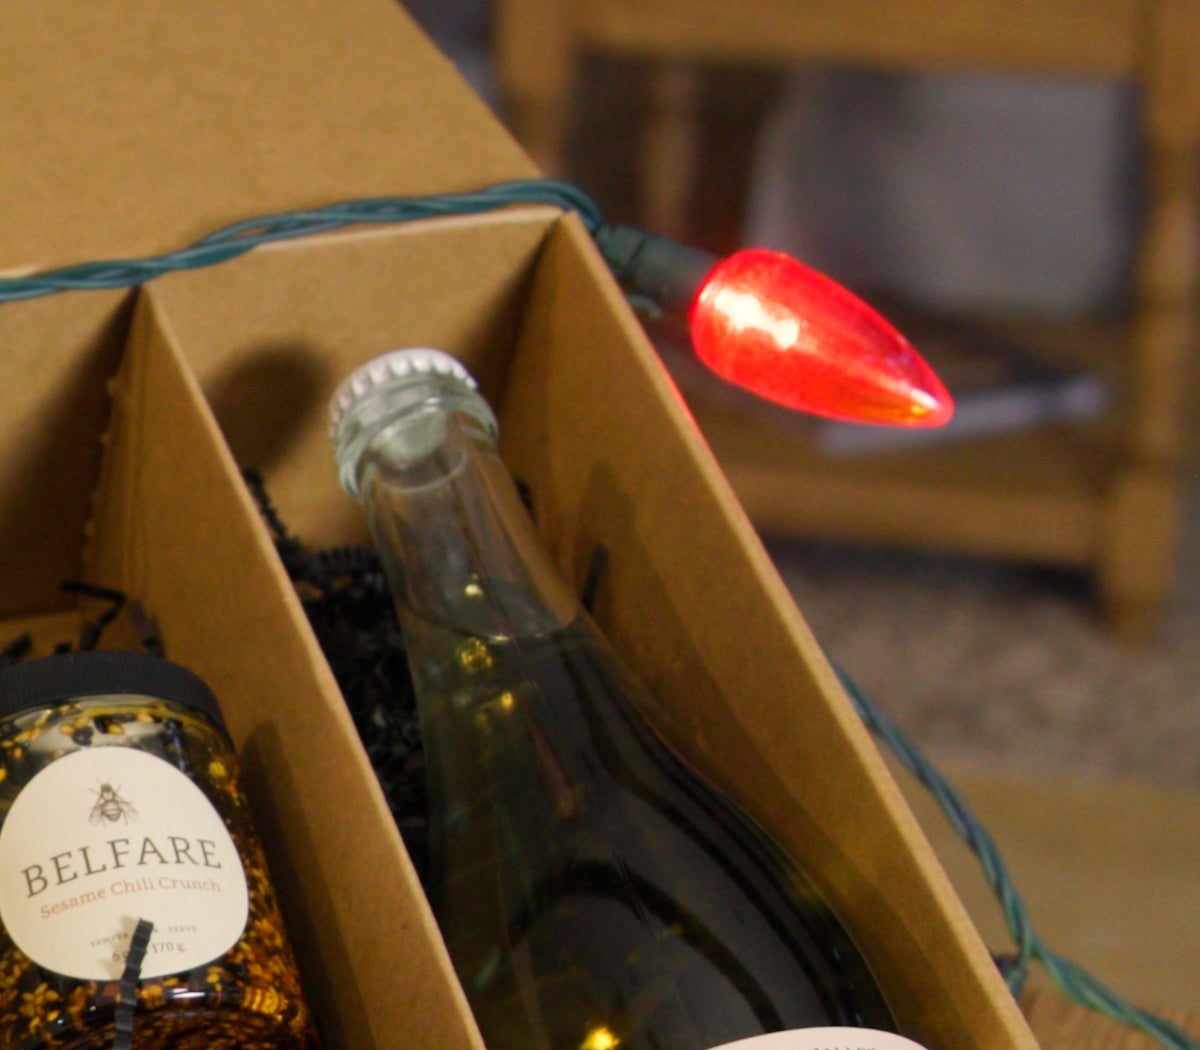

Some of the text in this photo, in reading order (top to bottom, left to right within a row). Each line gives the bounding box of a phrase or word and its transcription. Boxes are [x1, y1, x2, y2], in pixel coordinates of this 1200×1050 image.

[21, 836, 222, 898] BELFARE
[40, 875, 222, 919] Sesame Chili Crunch
[152, 942, 174, 954] 170
